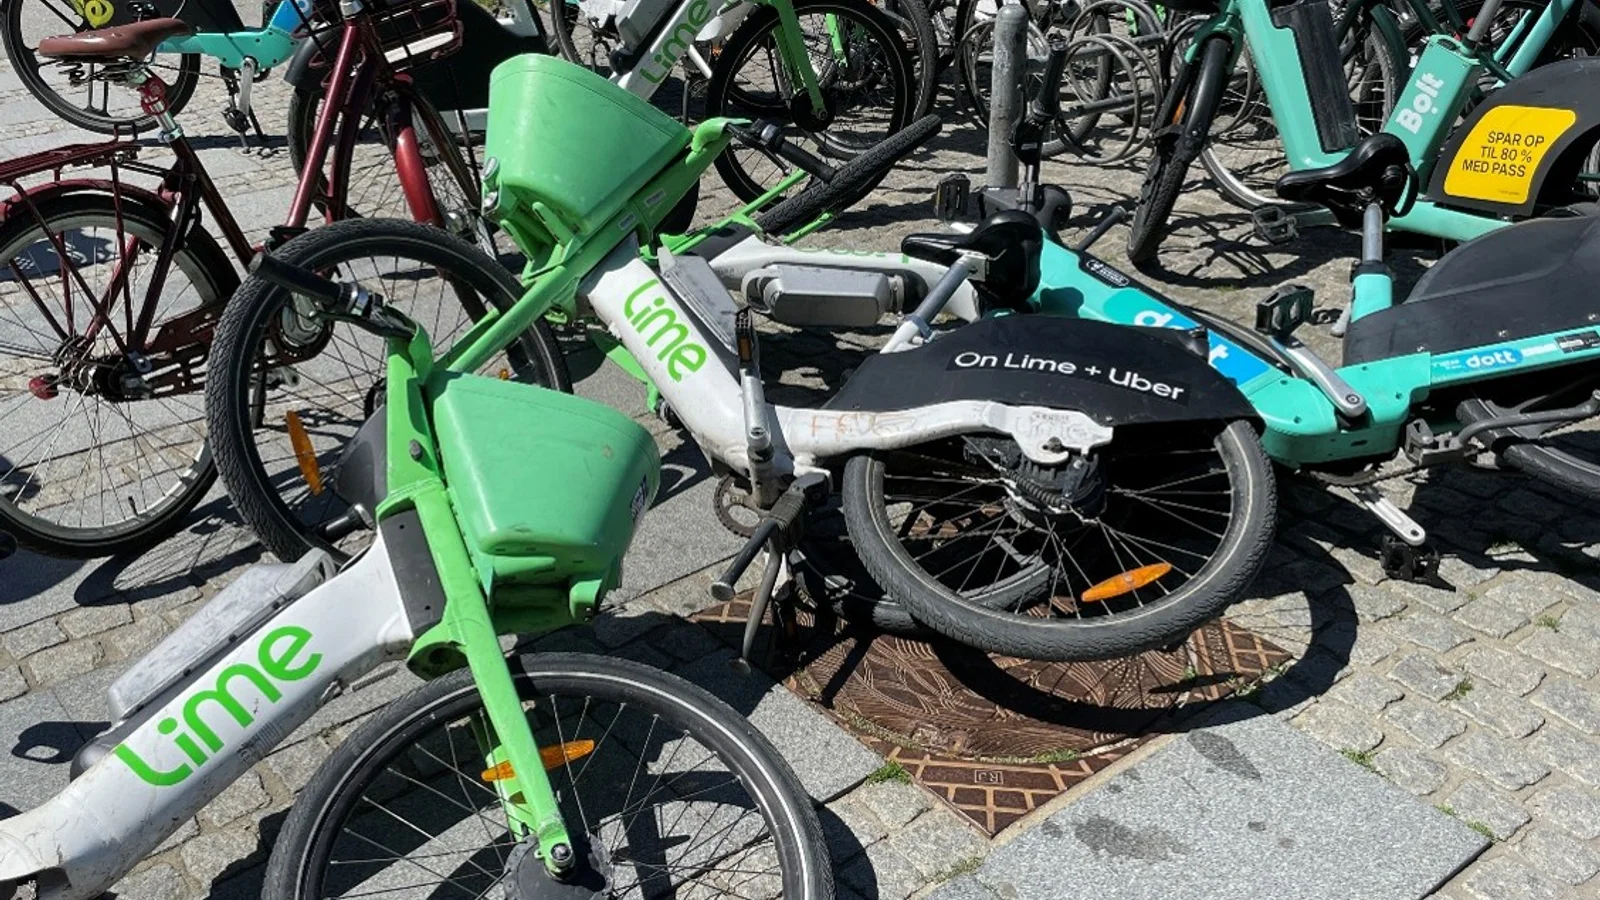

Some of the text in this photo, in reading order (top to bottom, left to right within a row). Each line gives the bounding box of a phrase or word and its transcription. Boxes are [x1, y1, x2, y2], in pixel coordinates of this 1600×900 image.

[1395, 73, 1444, 134] Bolt
[1481, 146, 1532, 163] TIL 80 %
[1488, 131, 1544, 147] SPAR OP
[1462, 159, 1526, 177] MED PASS
[624, 279, 707, 383] Lime
[1466, 350, 1517, 368] dott
[954, 352, 1184, 400] On Lime + Uber
[114, 626, 323, 786] Lime
